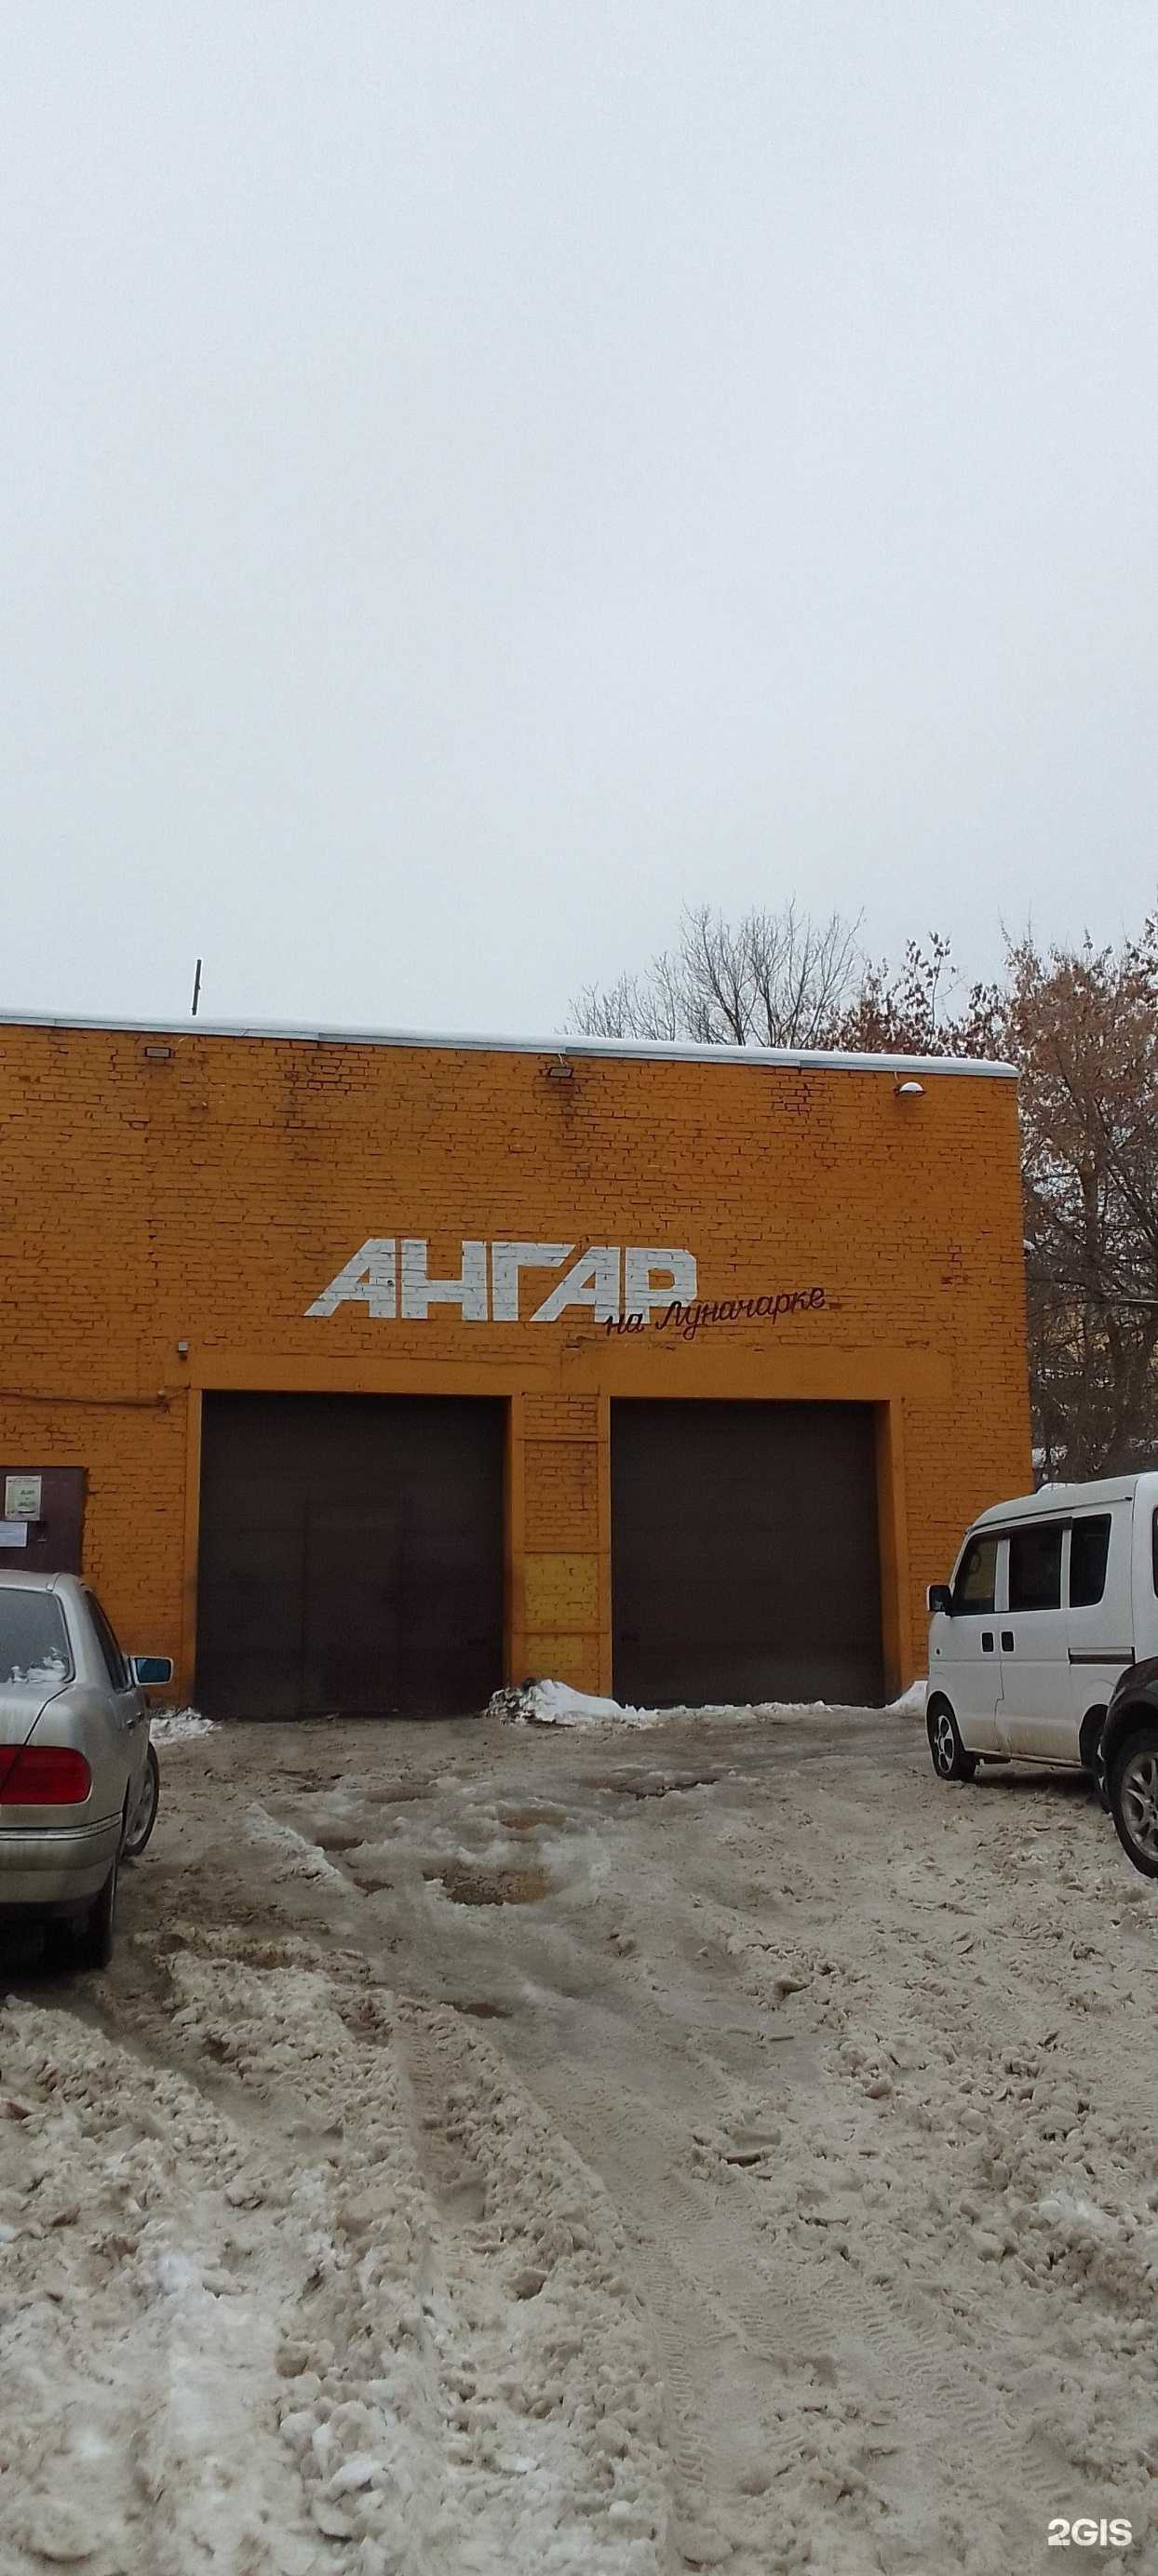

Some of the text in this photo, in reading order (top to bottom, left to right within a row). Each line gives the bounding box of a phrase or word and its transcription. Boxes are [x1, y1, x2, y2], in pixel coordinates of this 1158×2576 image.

[303, 1239, 699, 1322] АНГАР
[604, 1286, 827, 1340] на Луначарке
